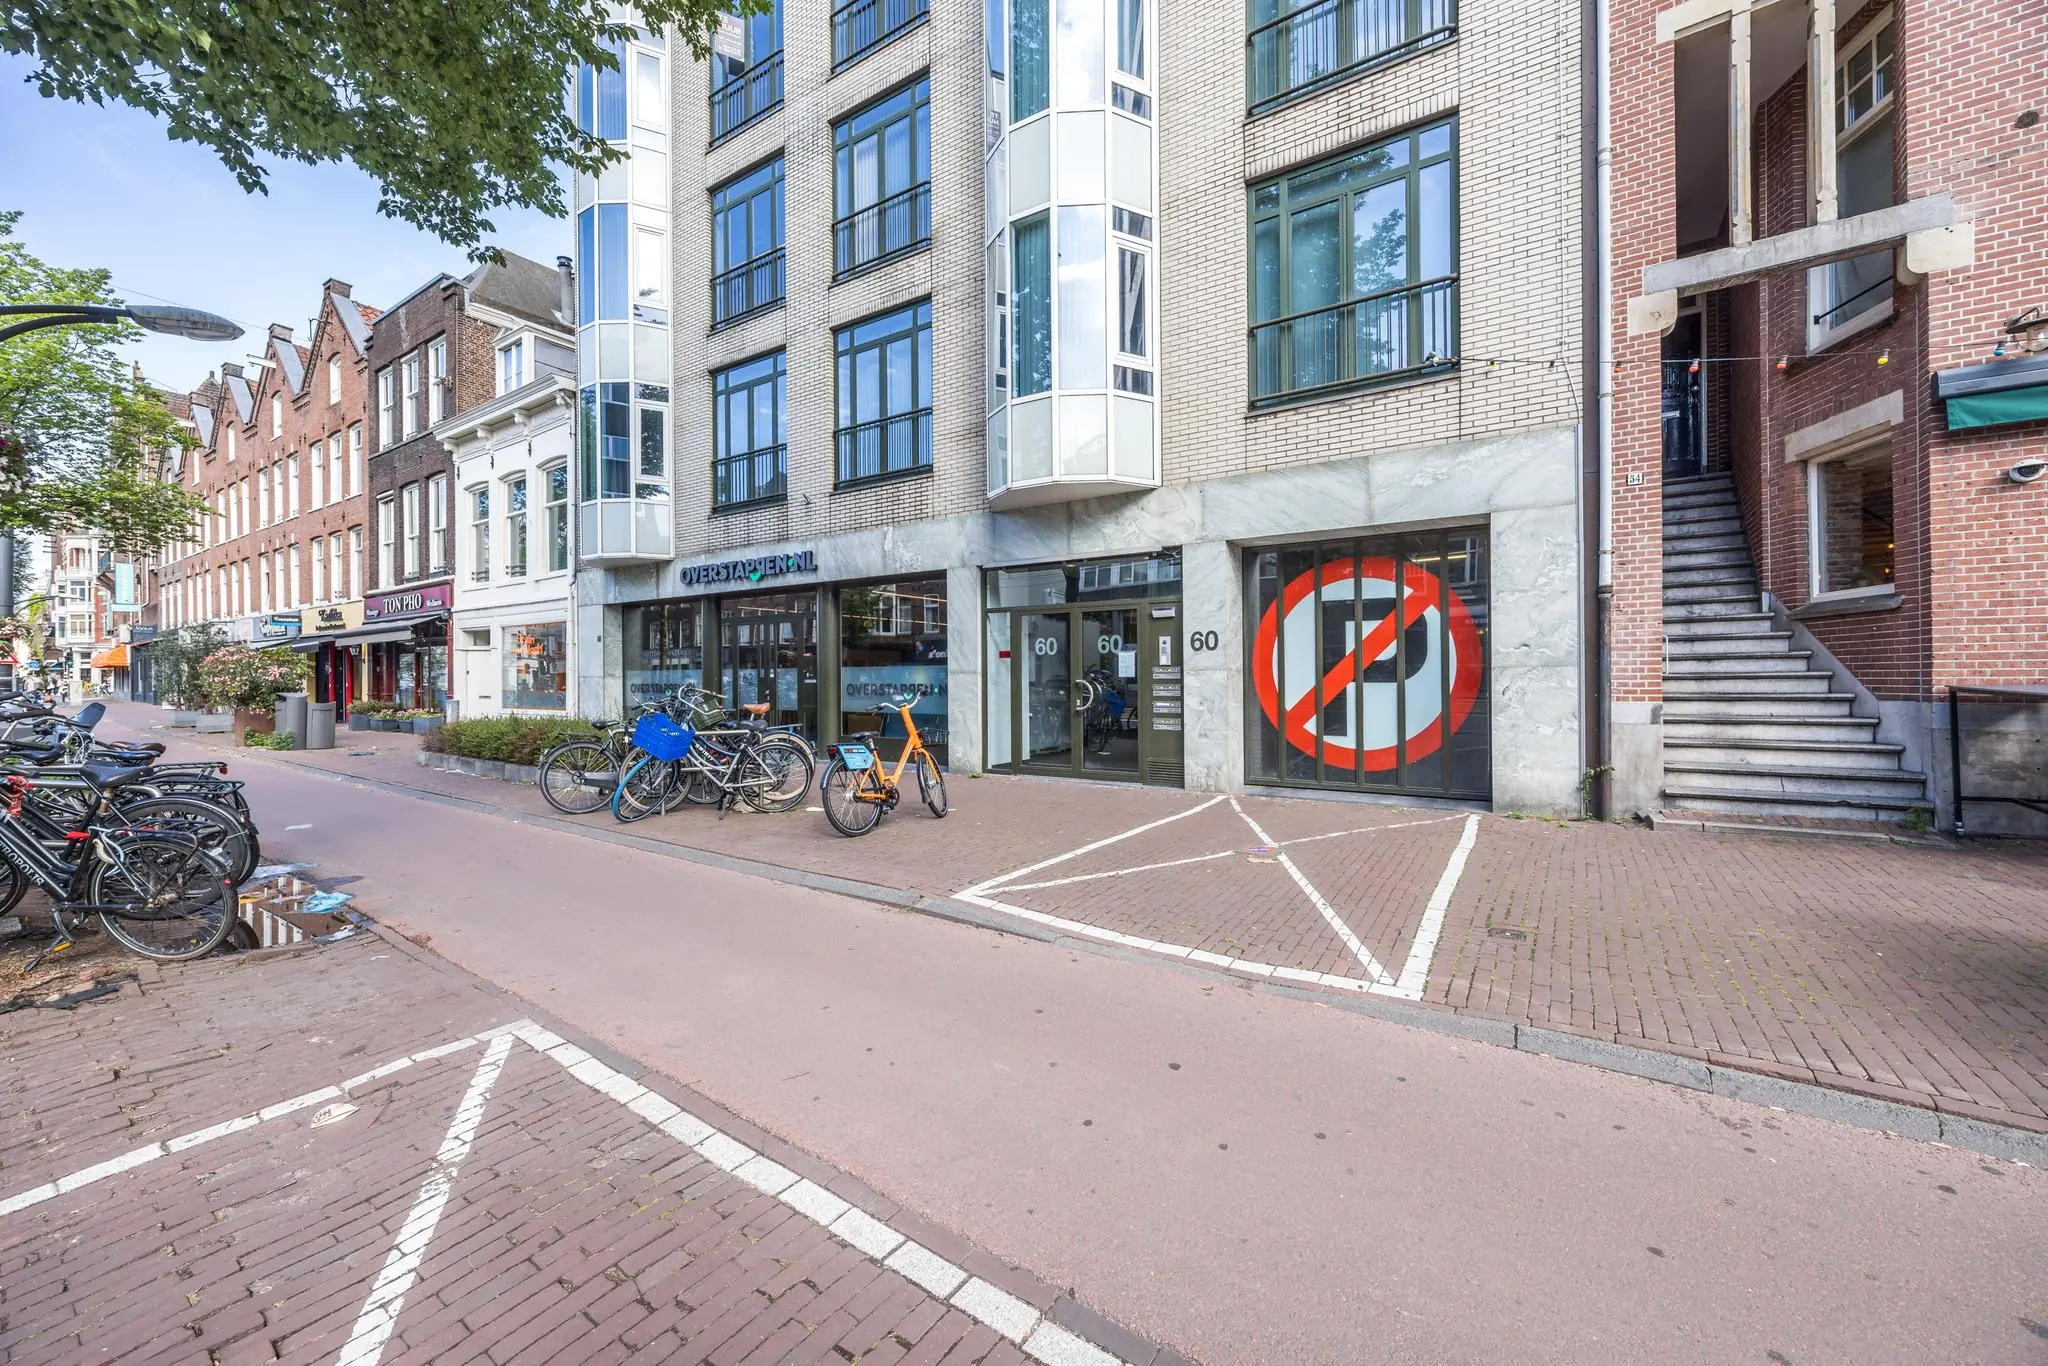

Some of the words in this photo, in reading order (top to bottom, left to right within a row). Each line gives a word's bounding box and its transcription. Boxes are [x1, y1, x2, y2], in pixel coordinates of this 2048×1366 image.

[1629, 474, 1640, 483] 54
[680, 551, 818, 585] OVERSTAPPEN.NL
[383, 596, 402, 614] TON
[403, 593, 422, 611] PHO
[1034, 637, 1058, 656] 60
[1097, 634, 1123, 656] 60
[1190, 630, 1219, 652] 60
[1322, 598, 1428, 736] P
